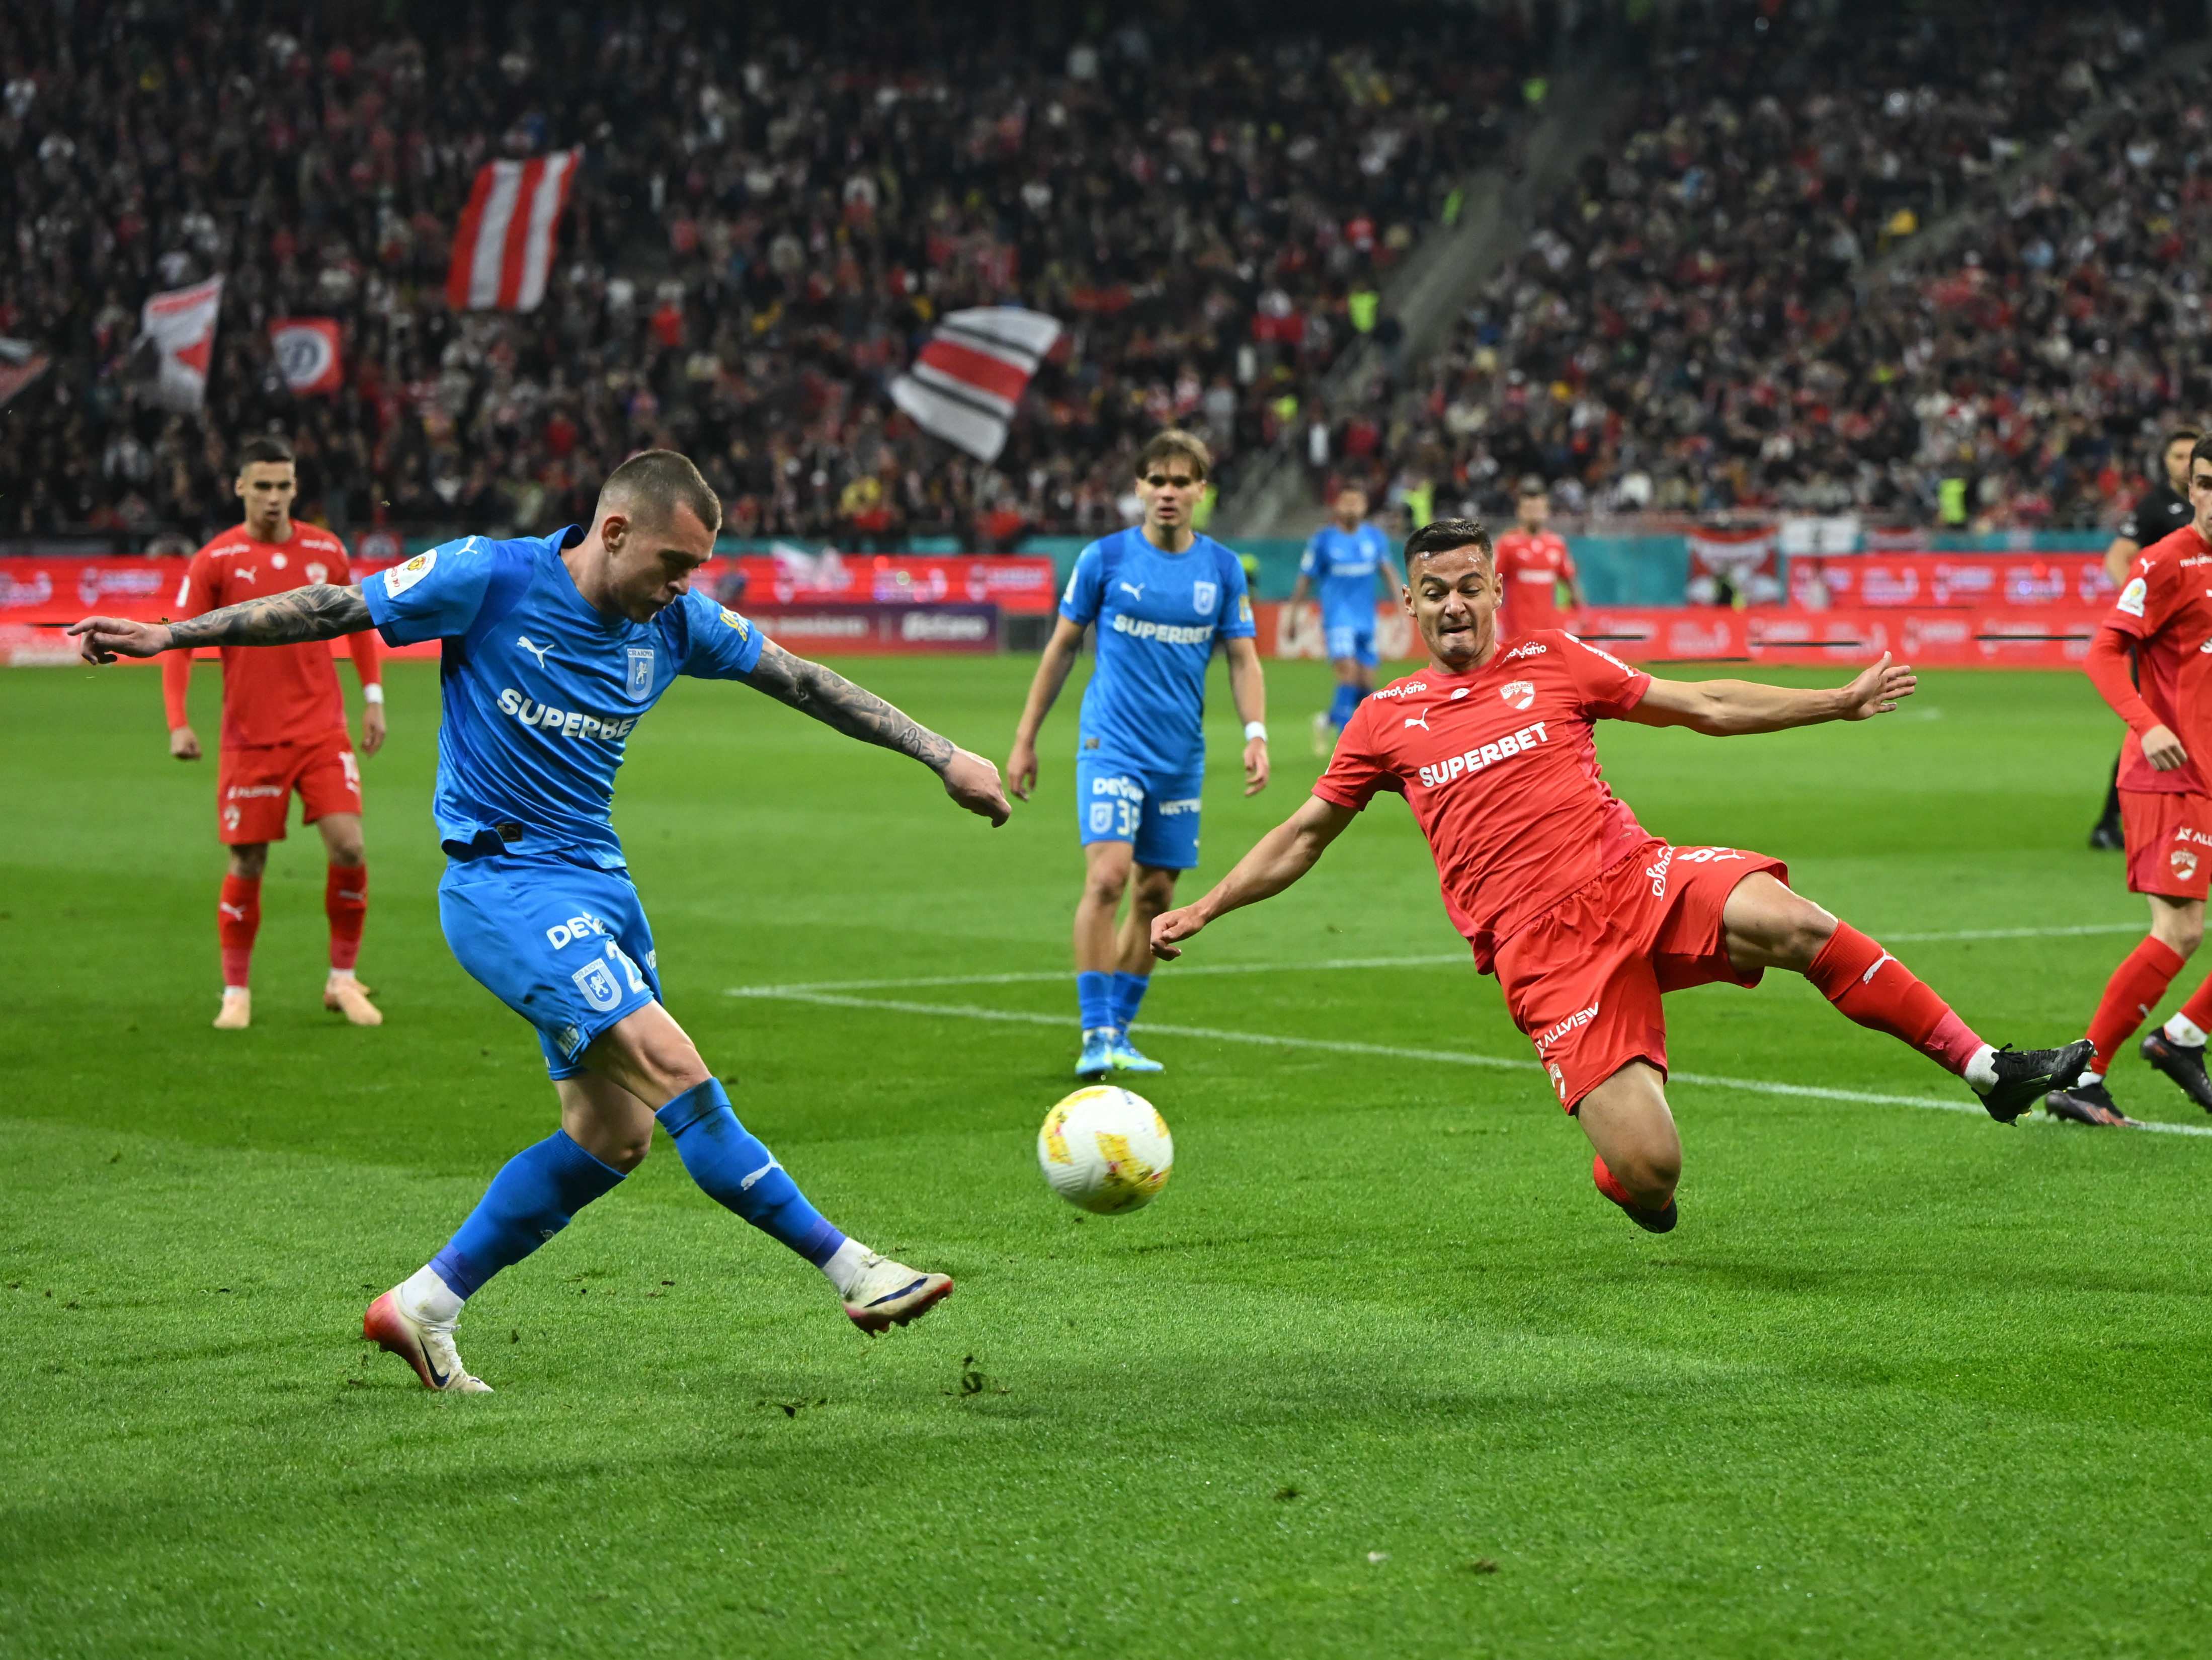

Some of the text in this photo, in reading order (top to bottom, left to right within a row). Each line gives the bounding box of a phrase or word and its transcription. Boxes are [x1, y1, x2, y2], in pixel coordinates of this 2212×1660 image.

[1113, 614, 1213, 645] SUPERBET
[1502, 683, 1532, 693] DINAMO
[1420, 722, 1548, 787] SUPERBET
[574, 960, 604, 982] CRAIOVA
[1544, 1001, 1599, 1048] ALLVIEW
